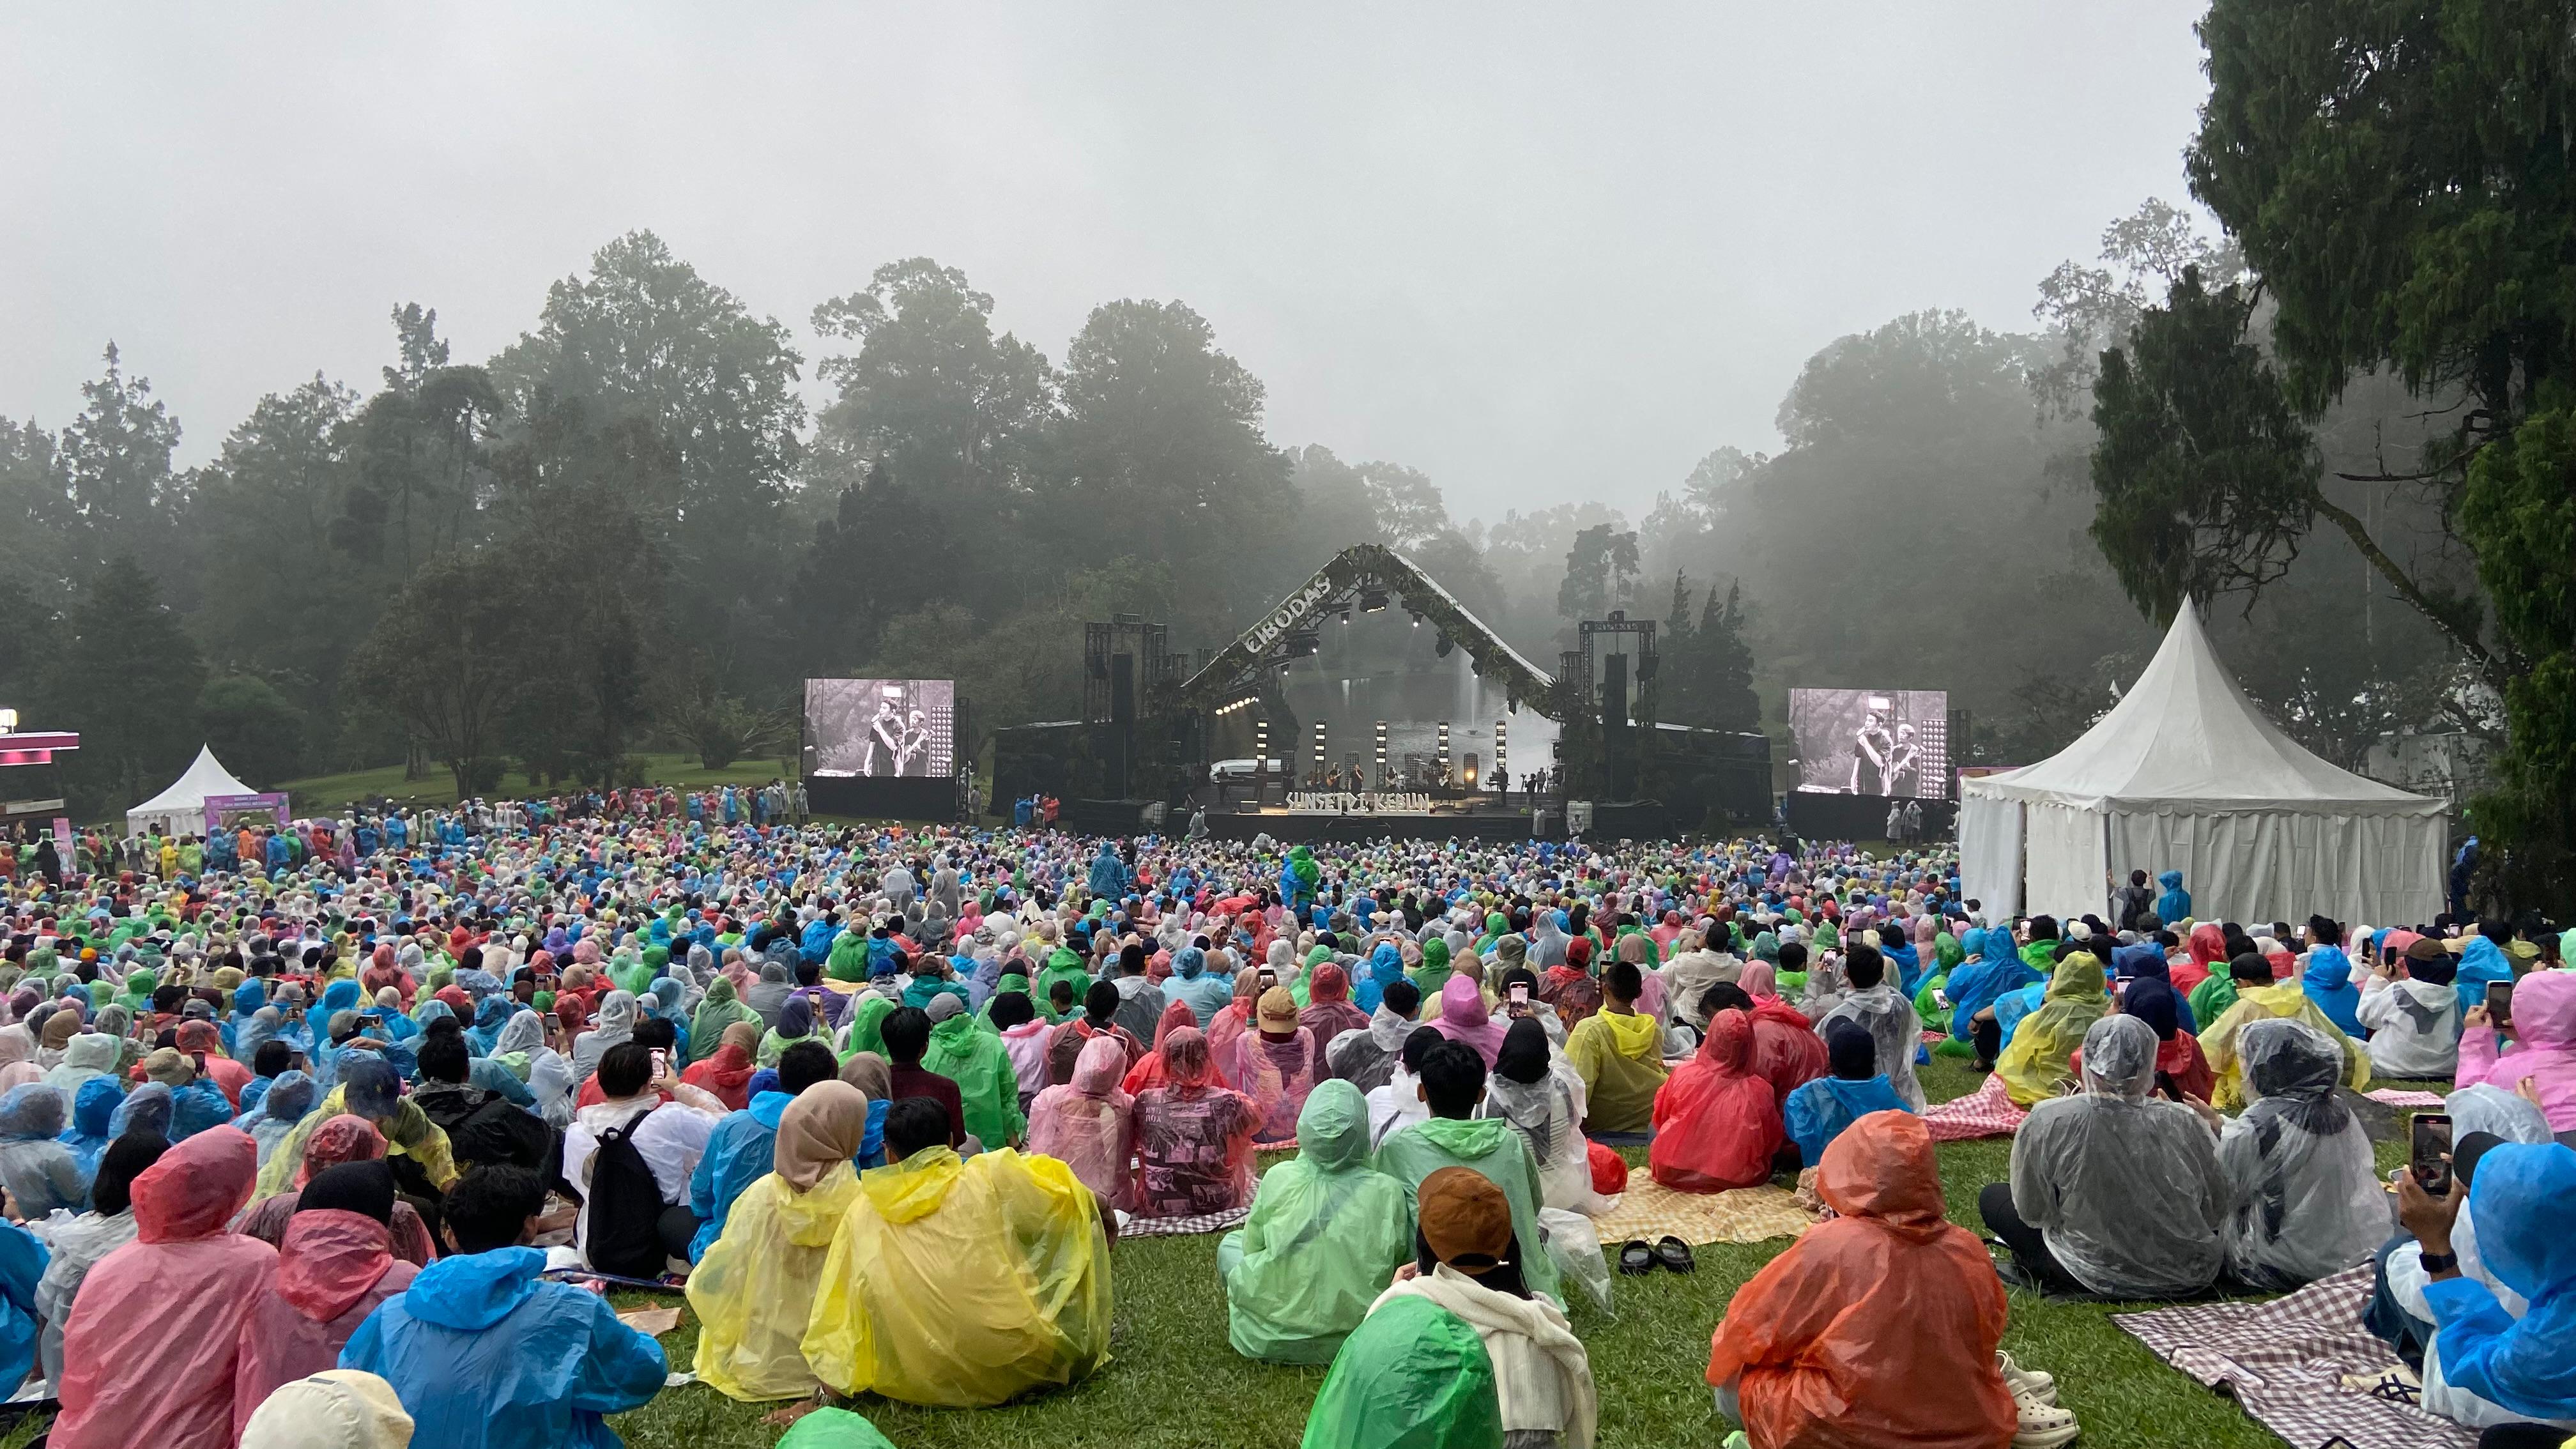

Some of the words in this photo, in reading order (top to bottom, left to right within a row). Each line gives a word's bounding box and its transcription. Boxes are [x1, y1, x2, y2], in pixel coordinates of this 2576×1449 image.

[1243, 576, 1330, 653] CIBODAS
[1285, 792, 1345, 811] SUNSET
[1346, 792, 1366, 811] DI
[1374, 792, 1429, 811] KEBUN
